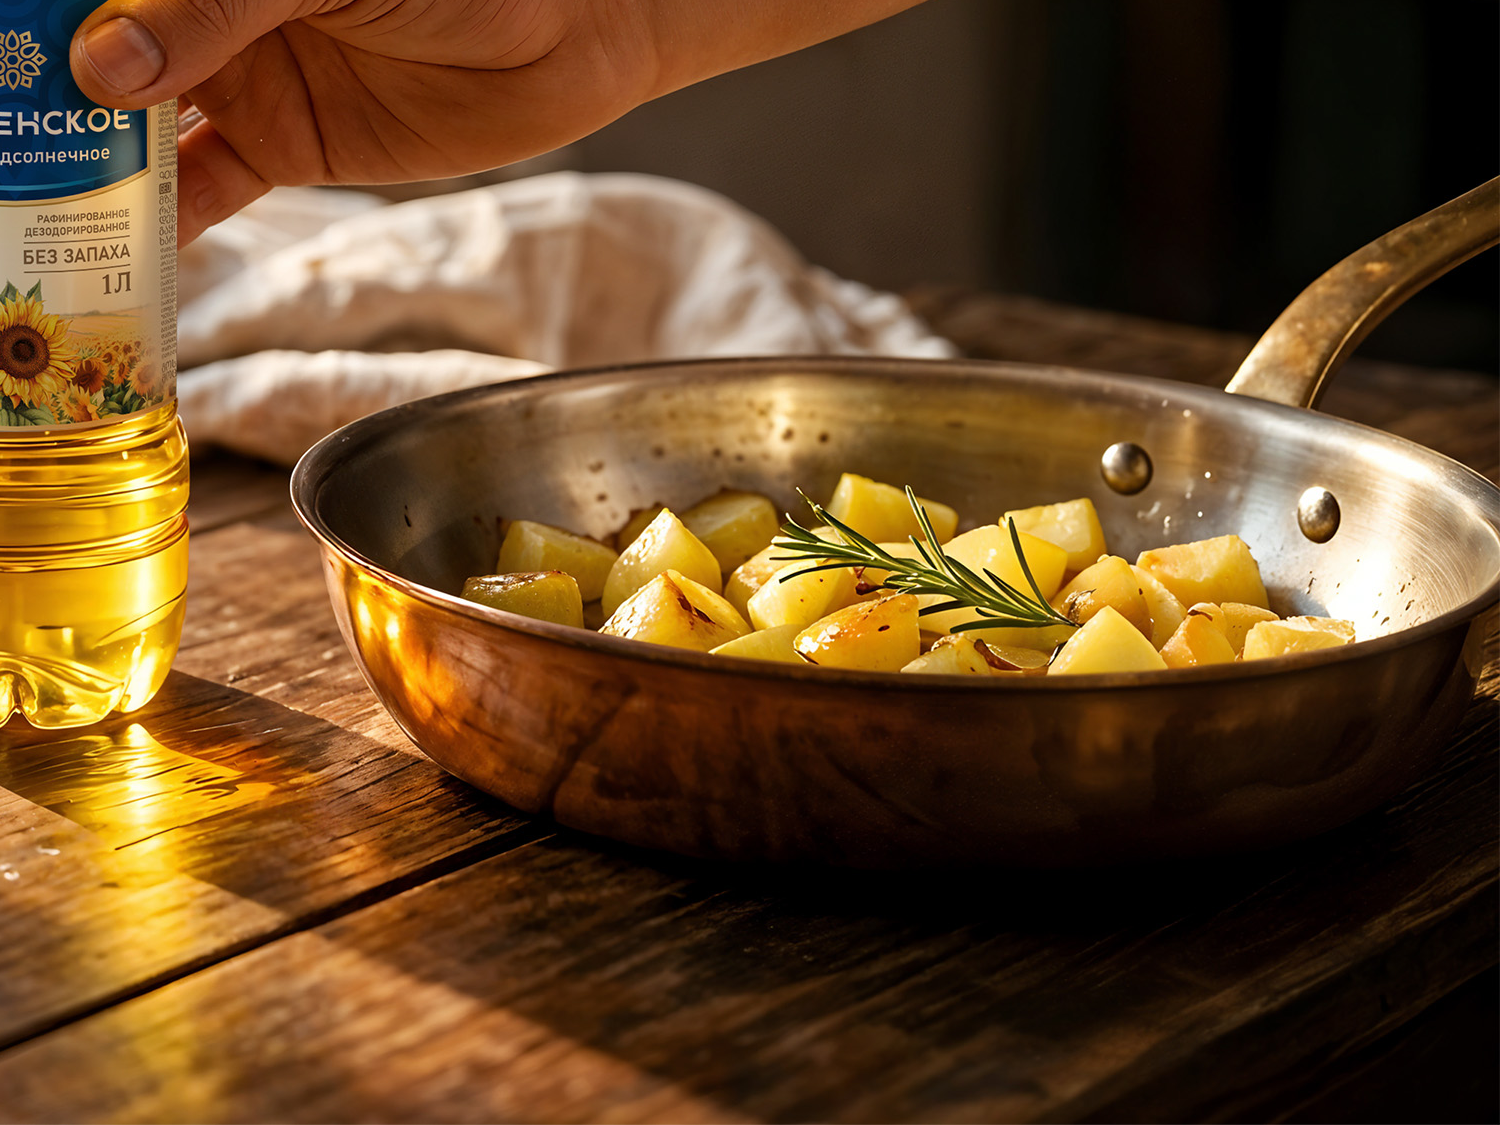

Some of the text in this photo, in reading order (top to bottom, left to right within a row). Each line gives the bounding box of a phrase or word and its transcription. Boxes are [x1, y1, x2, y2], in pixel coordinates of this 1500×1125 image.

[37, 208, 130, 223] РАФИНИРОВАННОЕ
[24, 221, 130, 238] ДЕЗОДОРИРОВАННОЕ
[23, 243, 130, 265] БЕЗ ЗАПАХА
